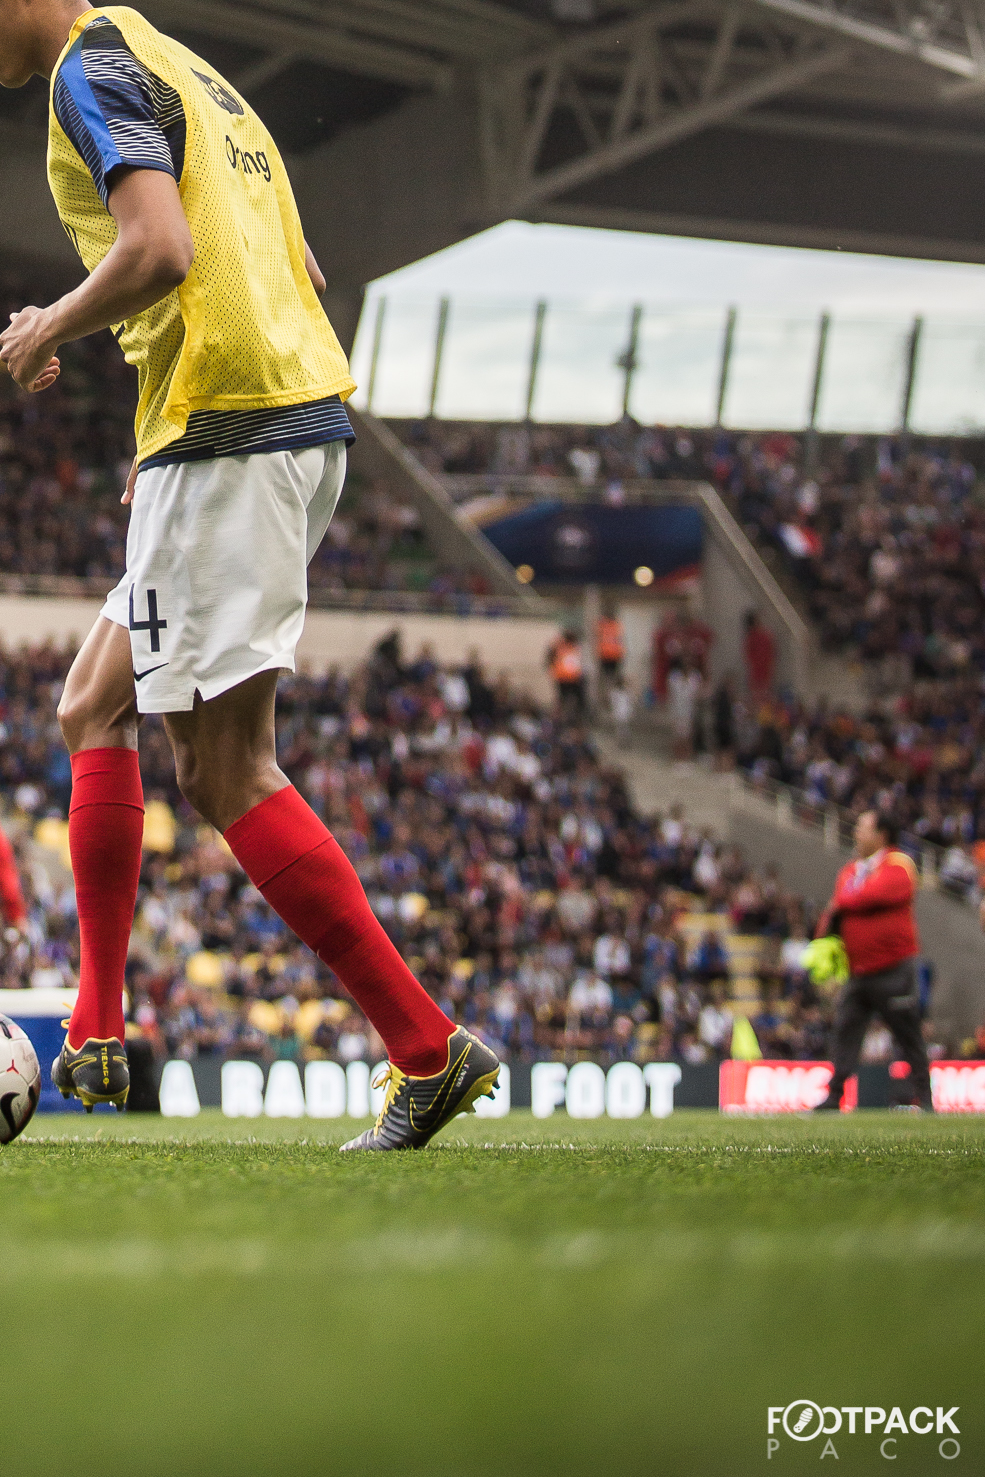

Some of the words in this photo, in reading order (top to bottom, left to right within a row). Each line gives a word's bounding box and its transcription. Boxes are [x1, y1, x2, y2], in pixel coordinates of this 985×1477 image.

[128, 582, 168, 653] 4
[159, 1059, 201, 1117] A
[530, 1061, 682, 1119] FOOT
